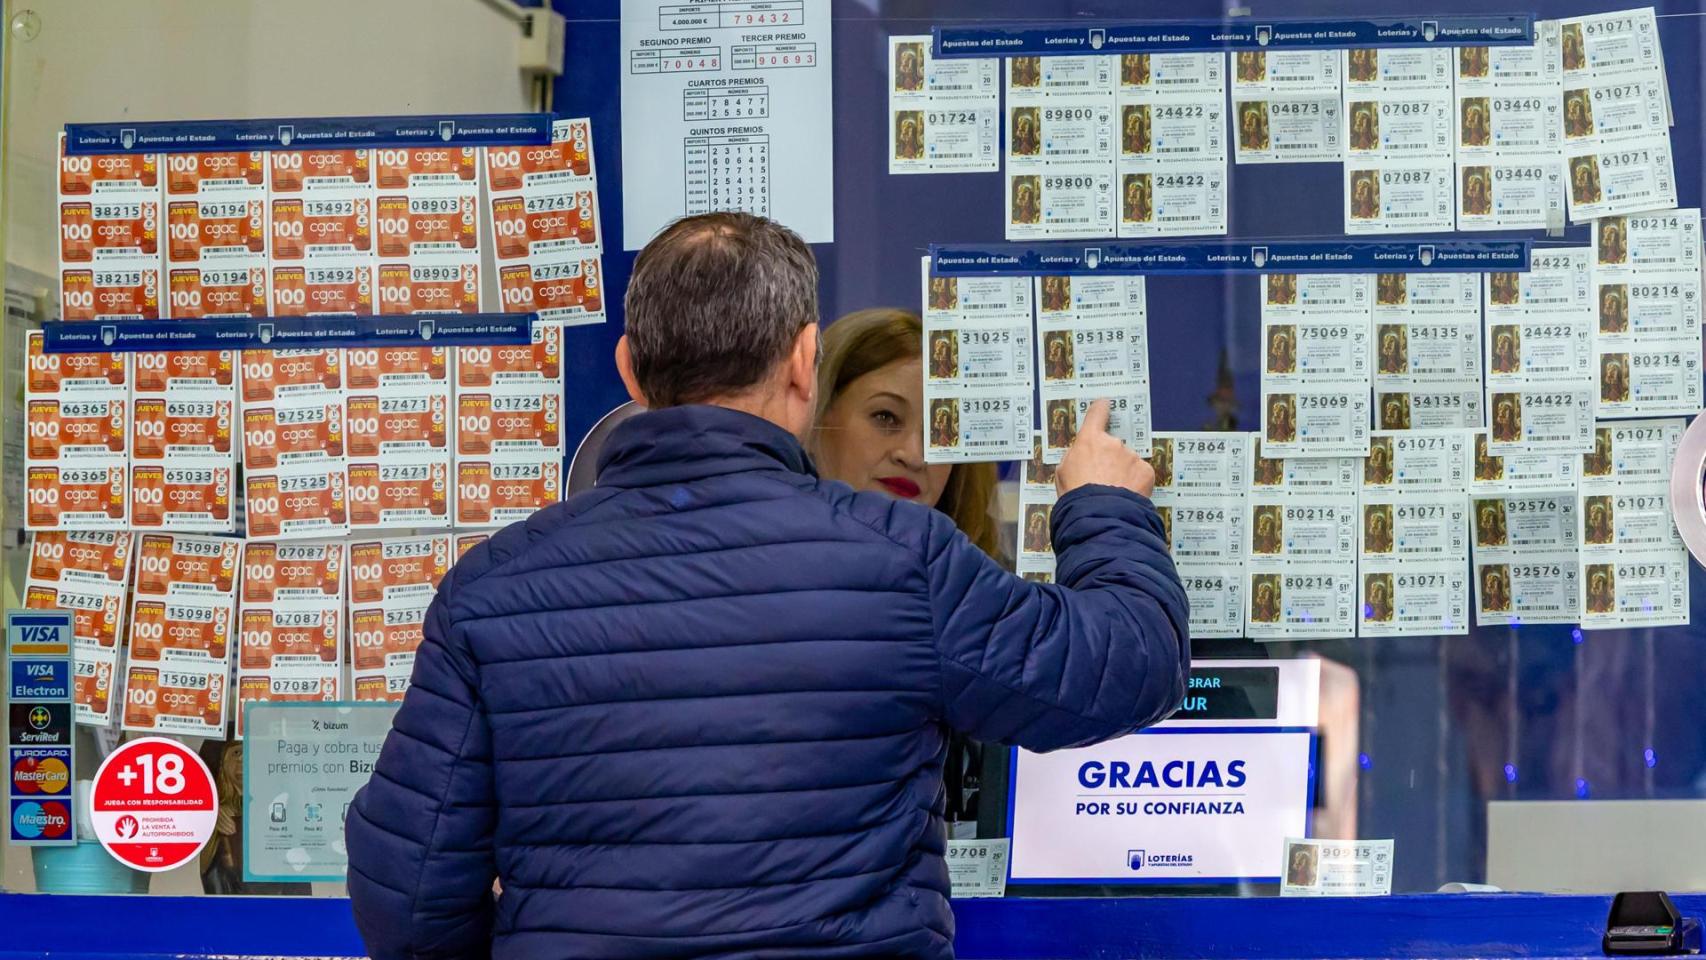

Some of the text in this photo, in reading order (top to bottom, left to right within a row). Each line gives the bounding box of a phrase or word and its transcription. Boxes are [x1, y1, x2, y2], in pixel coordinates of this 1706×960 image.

[1587, 20, 1632, 33] 61071
[1108, 35, 1144, 43] Apuestas
[1594, 86, 1641, 99] 61071
[1272, 104, 1319, 114] 04873
[1383, 104, 1429, 114] 07087
[1494, 100, 1540, 110] 03440
[1045, 109, 1092, 120] 89800
[1156, 106, 1203, 118] 24422
[929, 113, 976, 124] 01724
[690, 126, 763, 136] QUINTOS PREMIOS
[1602, 152, 1649, 166] 61071
[1384, 172, 1430, 183] 07087
[1496, 168, 1542, 179] 03440
[1045, 178, 1093, 189] 89800
[1157, 175, 1204, 187] 24422
[308, 203, 352, 213] 15492
[411, 200, 457, 210] 08903
[528, 196, 574, 210] 47747
[95, 206, 140, 216] 38215
[201, 205, 246, 215] 60194
[1631, 218, 1678, 228] 80214
[62, 224, 92, 239] 100
[1532, 257, 1570, 268] 4422
[309, 270, 354, 281] 15492
[413, 268, 459, 278] 08903
[534, 264, 580, 278] 47747
[96, 273, 140, 283] 38215
[203, 272, 248, 282] 60194
[503, 272, 529, 281] JUEVES
[503, 287, 533, 304] 100
[1632, 286, 1679, 296] 80214
[1077, 330, 1124, 342] 95138
[1301, 328, 1348, 338] 75069
[1412, 328, 1458, 338] 54135
[1524, 327, 1571, 337] 24422
[963, 332, 1010, 343] 31025
[1633, 355, 1680, 365] 80214
[382, 400, 427, 410] 27471
[494, 399, 540, 409] 01724
[1300, 397, 1347, 407] 75069
[1414, 396, 1460, 406] 54135
[1525, 395, 1572, 405] 24422
[63, 404, 108, 414] 66365
[168, 404, 214, 414] 65033
[963, 400, 1010, 411] 31025
[278, 409, 324, 421] 97525
[1616, 430, 1663, 440] 61071
[1178, 441, 1226, 451] 57864
[1399, 439, 1445, 449] 61071
[63, 471, 108, 481] 66365
[166, 471, 212, 481] 65033
[383, 467, 427, 478] 27471
[494, 466, 540, 476] 01724
[281, 477, 327, 489] 97525
[134, 488, 163, 503] 100
[1508, 502, 1556, 512] 92576
[1617, 498, 1664, 508] 61071
[1177, 511, 1224, 521] 57864
[1287, 509, 1334, 519] 80214
[1398, 507, 1445, 517] 61071
[70, 532, 113, 544] 27478
[177, 542, 221, 554] 15098
[278, 548, 324, 558] 07087
[386, 543, 431, 555] 57514
[1513, 566, 1560, 577] 92576
[1619, 567, 1665, 577] 61071
[1185, 579, 1223, 590] 7864
[1286, 578, 1332, 587] 80214
[1398, 576, 1445, 586] 61071
[60, 594, 102, 608] 27478
[169, 607, 212, 620] 15098
[387, 611, 422, 622] 5751
[275, 614, 320, 624] 07087
[21, 627, 59, 641] VISA
[26, 665, 54, 676] VISA
[130, 673, 157, 682] JUEVES
[163, 674, 206, 686] 15098
[15, 686, 65, 696] Electron
[273, 681, 318, 691] 07087
[128, 689, 157, 705] 100
[1183, 697, 1207, 710] UR
[324, 721, 348, 730] bizum
[20, 732, 59, 742] ServiRed
[278, 740, 382, 756] Paga y cobra tus
[268, 762, 318, 775] premios
[323, 763, 344, 774] con
[117, 753, 186, 795] +18
[1078, 760, 1246, 788] GRACIAS
[1076, 802, 1245, 815] POR SU CONFIANZA
[950, 848, 986, 857] 9708
[1148, 854, 1193, 862] LOTERÍAS
